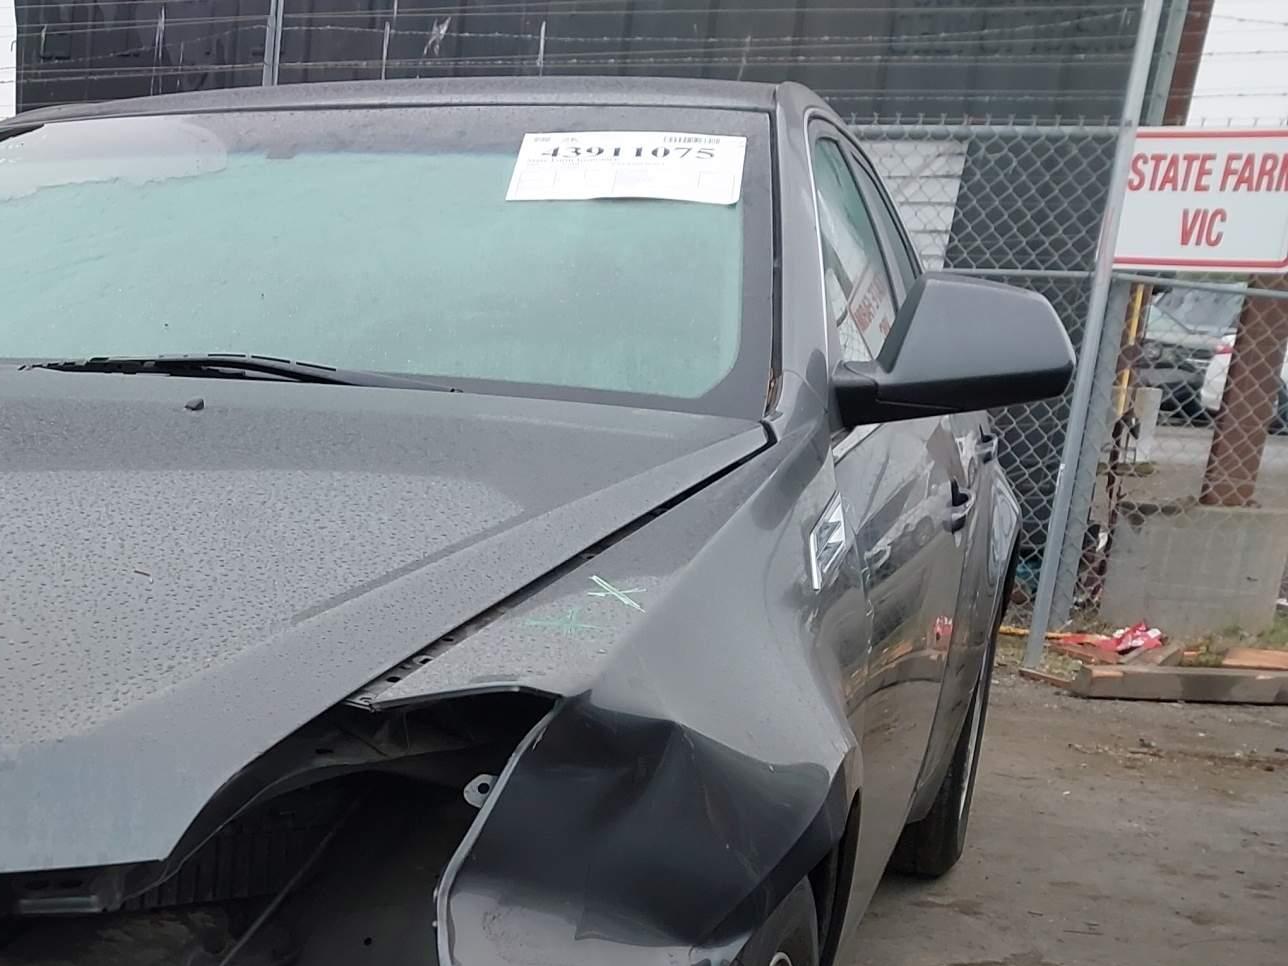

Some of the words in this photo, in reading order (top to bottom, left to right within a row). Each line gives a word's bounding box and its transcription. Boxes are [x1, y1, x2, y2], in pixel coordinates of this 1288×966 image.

[541, 145, 716, 160] 43911075
[1128, 152, 1217, 192] STATE
[1179, 207, 1228, 248] VIC
